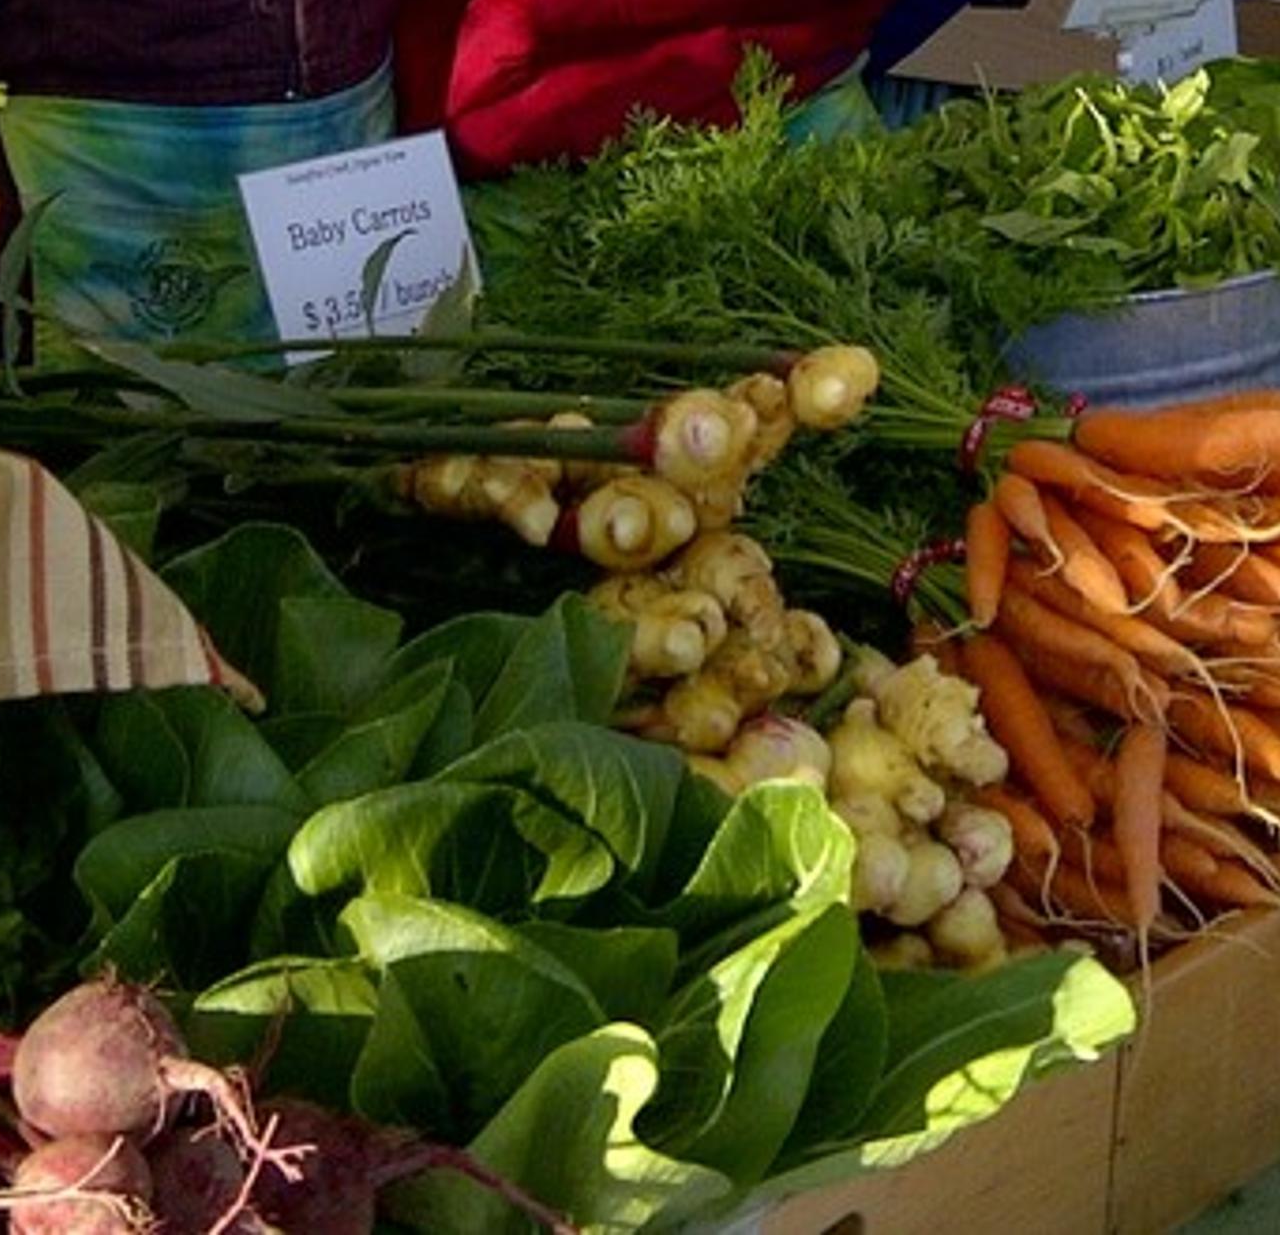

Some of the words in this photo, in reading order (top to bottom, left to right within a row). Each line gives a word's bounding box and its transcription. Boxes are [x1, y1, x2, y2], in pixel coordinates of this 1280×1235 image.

[286, 217, 347, 252] Baby
[351, 200, 432, 236] Carrots
[302, 300, 320, 330] $
[324, 289, 367, 328] 3.5
